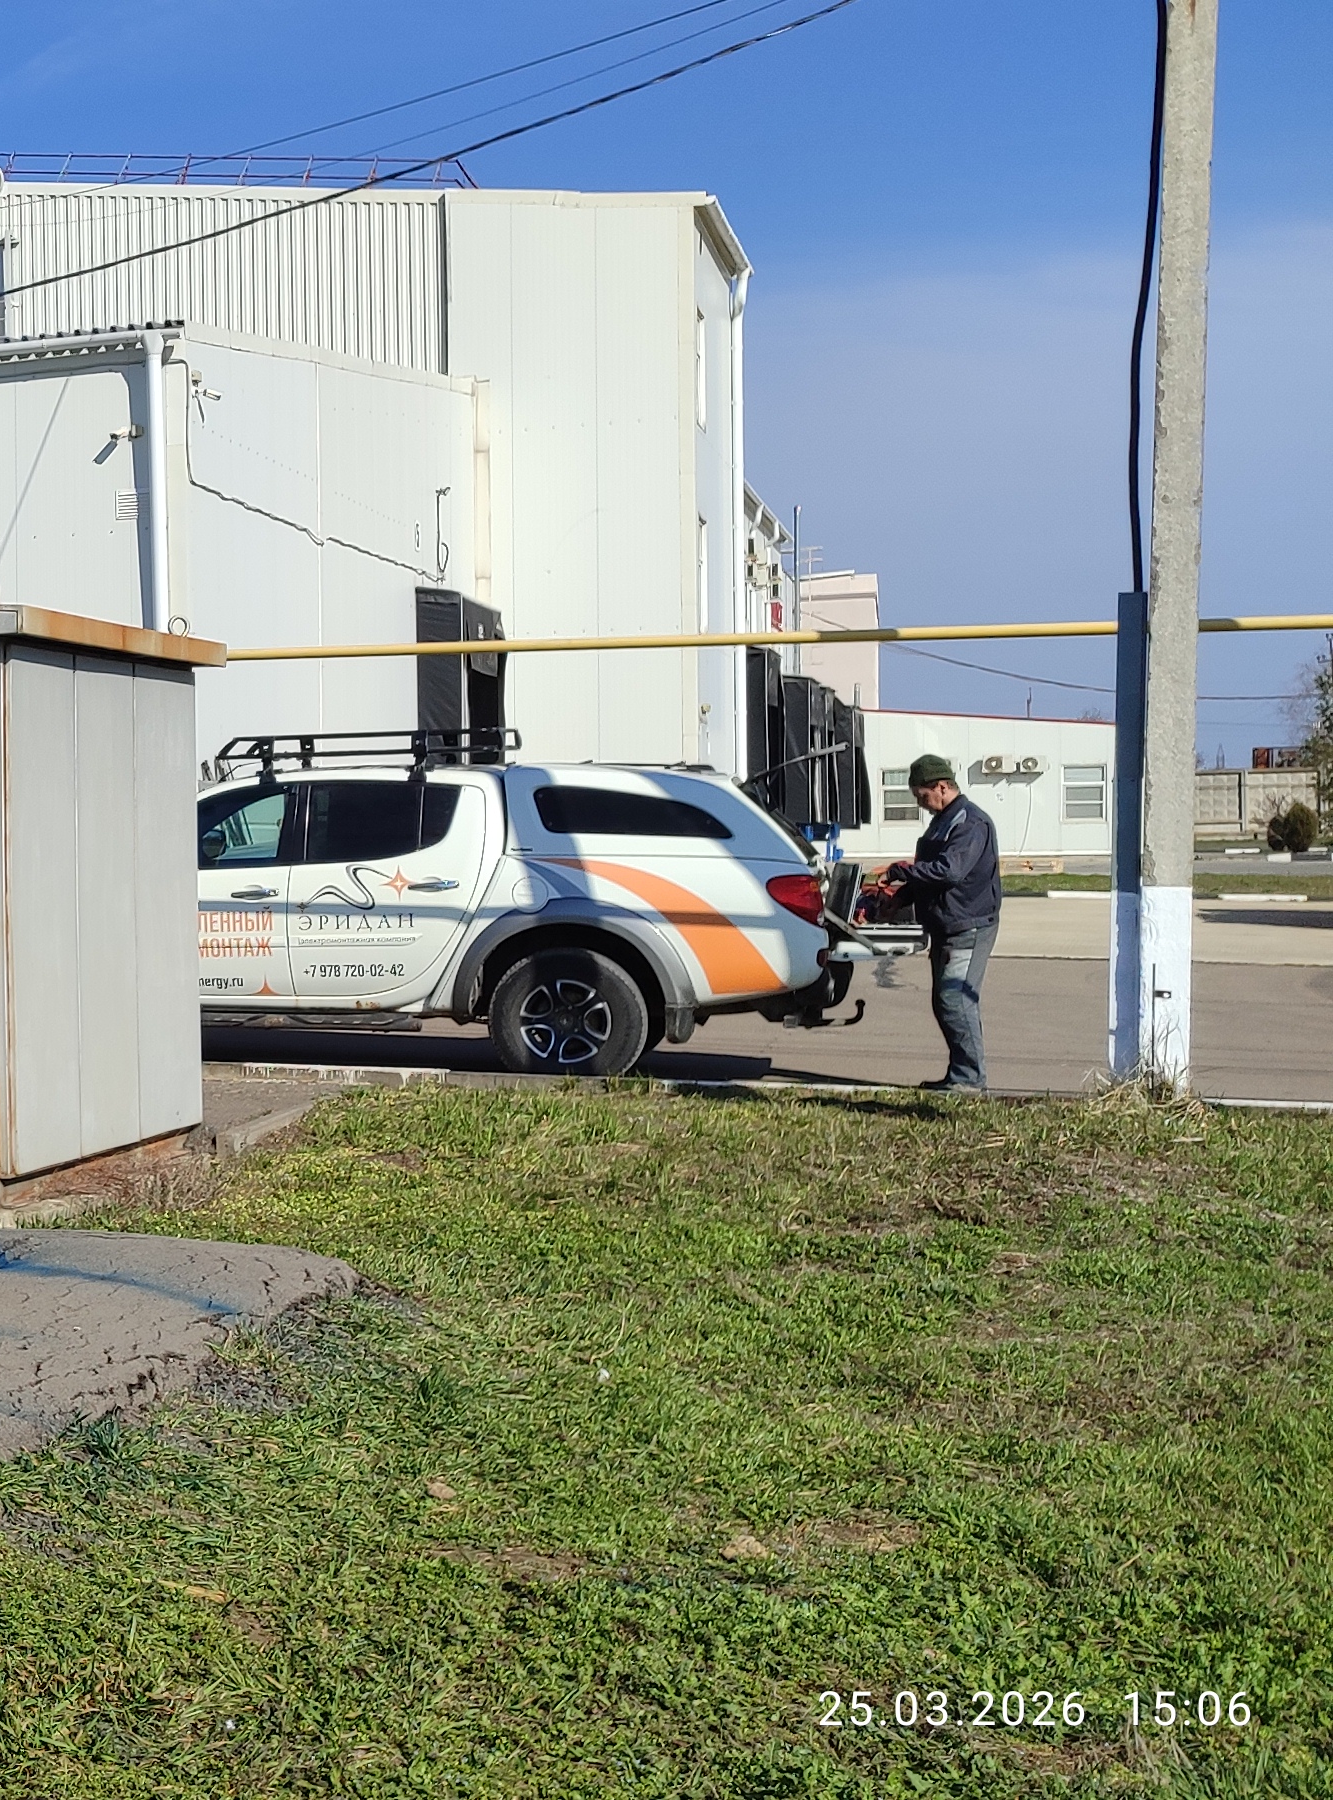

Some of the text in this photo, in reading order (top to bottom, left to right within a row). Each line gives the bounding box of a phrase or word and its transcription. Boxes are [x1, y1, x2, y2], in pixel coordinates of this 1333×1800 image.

[298, 913, 415, 932] ЭРИДАН
[303, 963, 406, 978] +7 978 720-02-42
